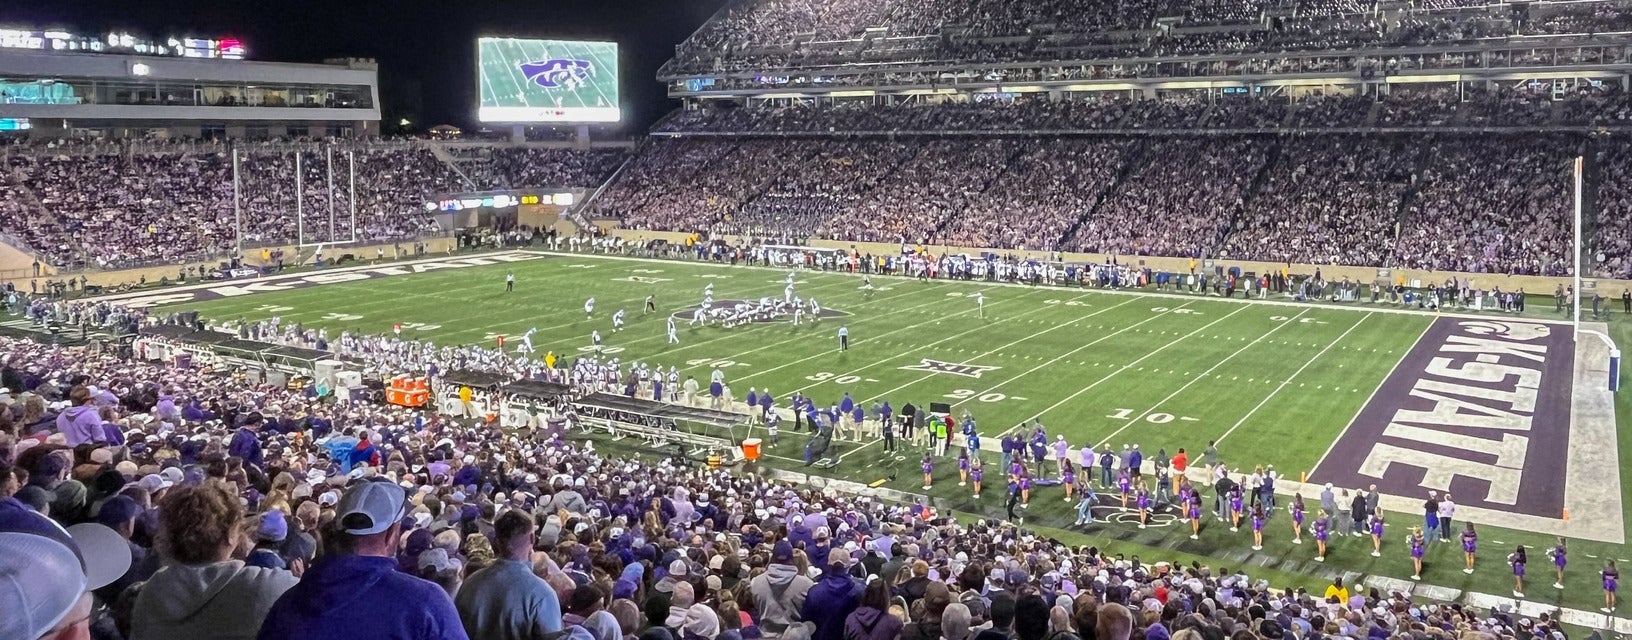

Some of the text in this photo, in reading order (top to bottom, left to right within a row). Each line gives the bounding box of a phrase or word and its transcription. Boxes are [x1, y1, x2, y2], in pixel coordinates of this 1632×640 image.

[805, 371, 862, 384] 30
[943, 389, 1006, 402] 20
[1106, 408, 1175, 424] 10
[1358, 335, 1549, 506] K-STATE
